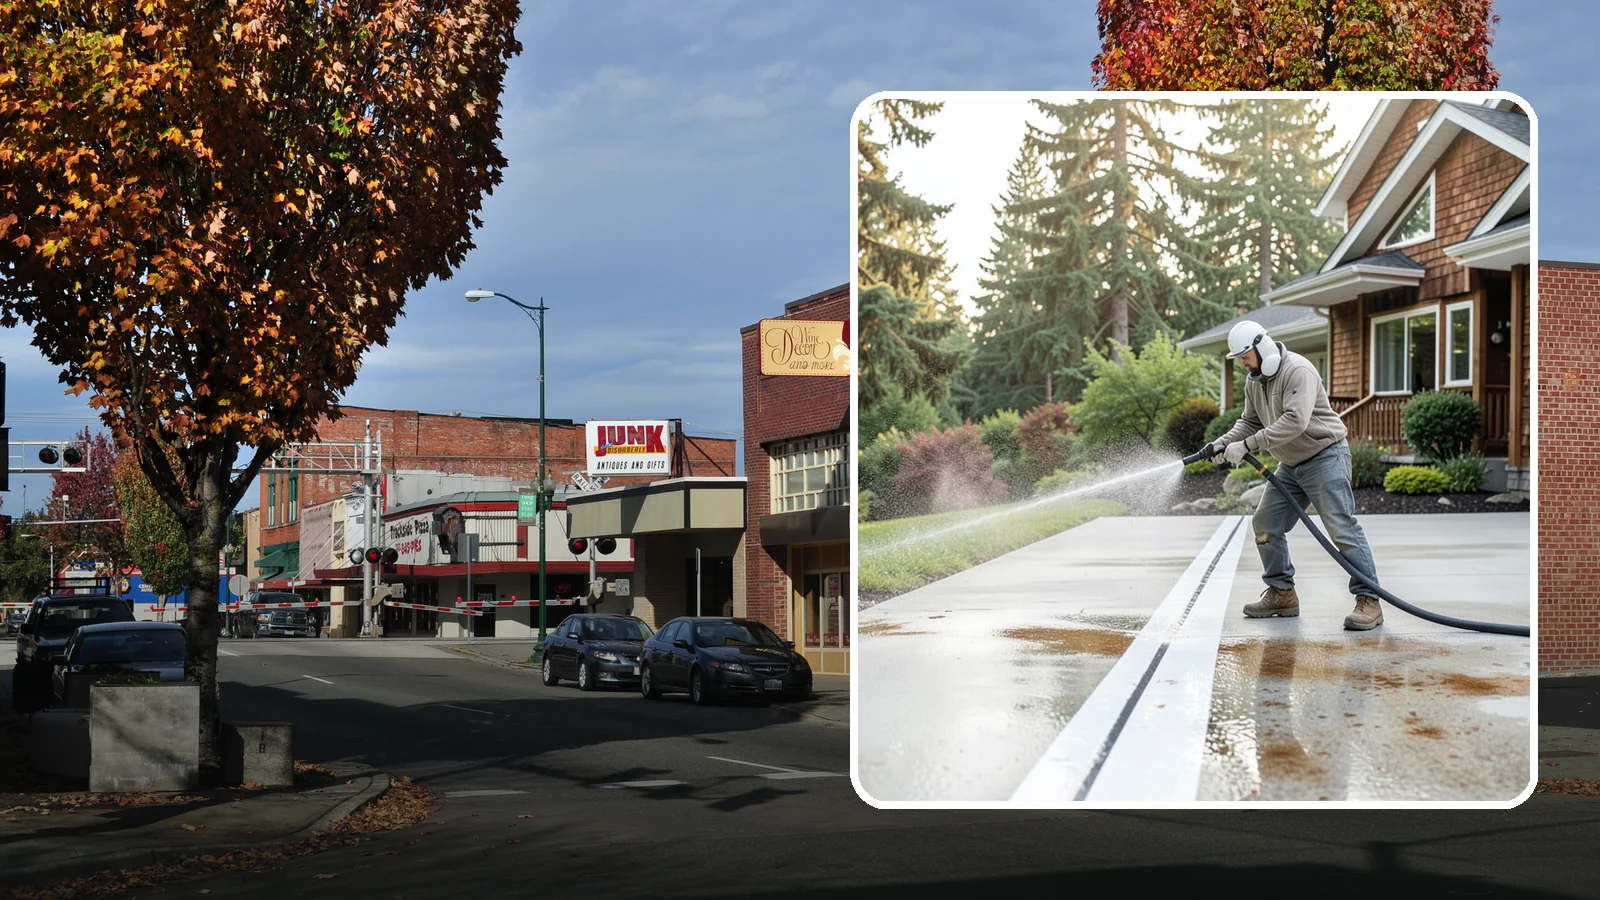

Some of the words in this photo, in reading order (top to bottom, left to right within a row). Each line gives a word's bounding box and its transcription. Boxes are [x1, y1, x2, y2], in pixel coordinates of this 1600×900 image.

[595, 425, 665, 457] JUNK
[607, 446, 646, 454] DISORDERLY
[597, 461, 628, 470] ANTIQUES
[631, 461, 644, 470] AND
[647, 460, 666, 469] GIFTS
[390, 520, 413, 540] Trackside
[415, 519, 429, 535] Pizza
